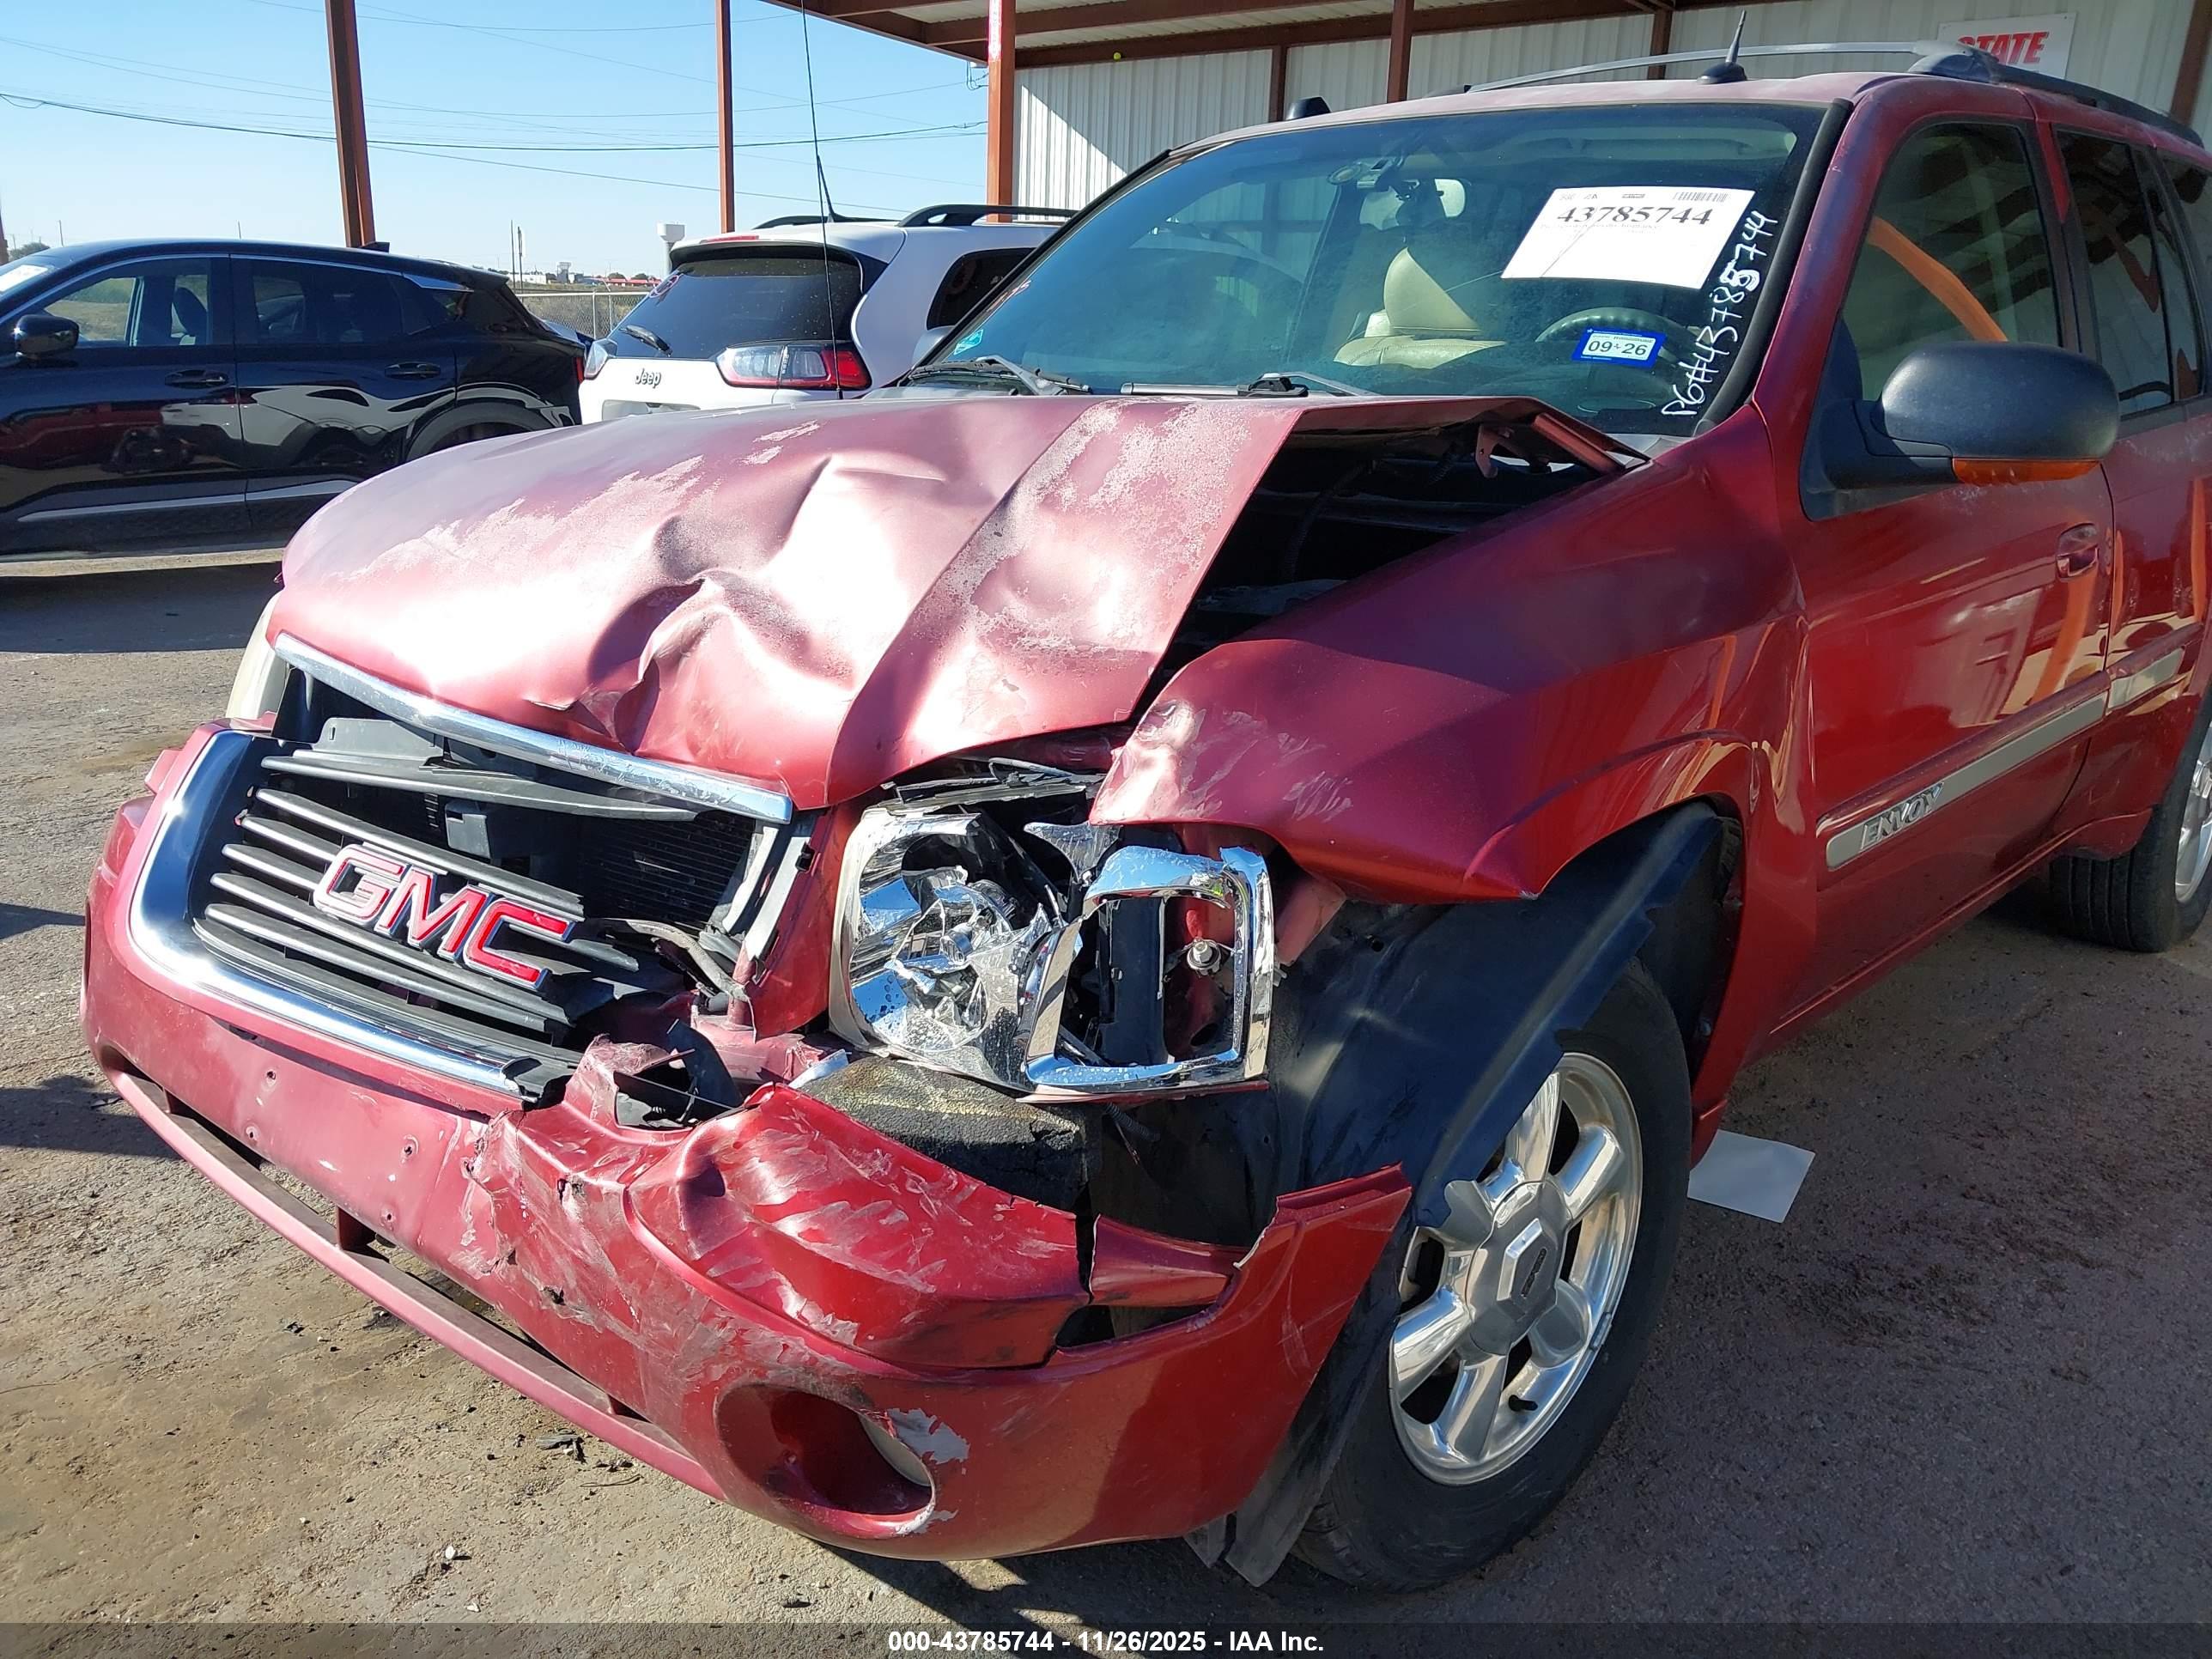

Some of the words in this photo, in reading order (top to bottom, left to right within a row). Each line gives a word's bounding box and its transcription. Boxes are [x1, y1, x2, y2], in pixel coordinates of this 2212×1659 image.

[1557, 206, 1712, 225] 43785744
[635, 368, 662, 389] Jeep
[1859, 781, 1945, 850] ENVOY
[313, 843, 575, 988] GMC
